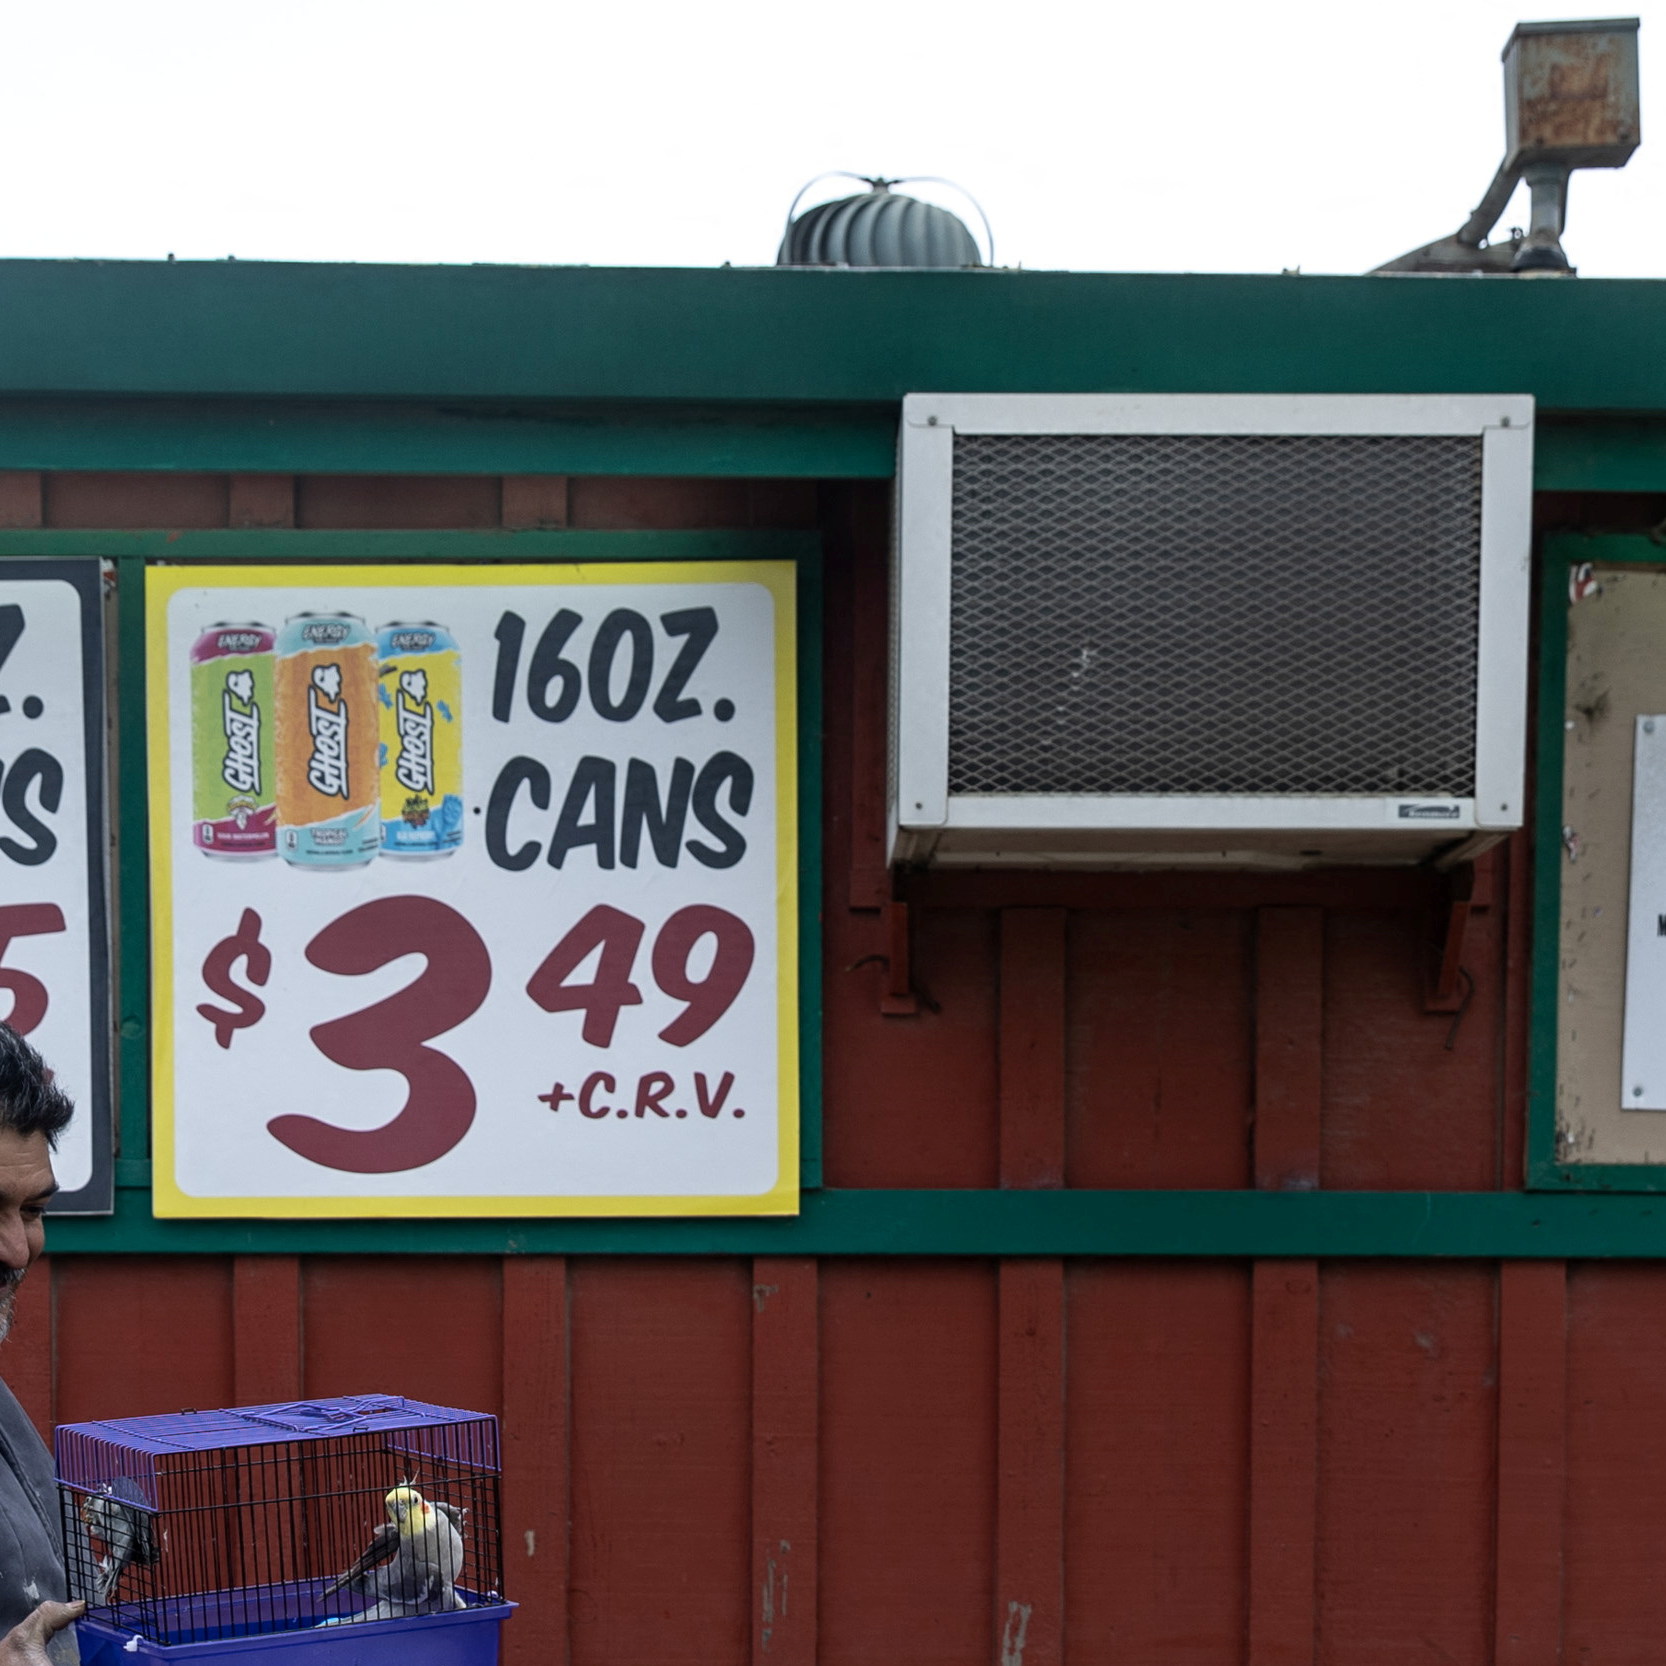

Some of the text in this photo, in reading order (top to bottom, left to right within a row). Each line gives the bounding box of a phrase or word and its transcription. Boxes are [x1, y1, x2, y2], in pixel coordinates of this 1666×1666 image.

[217, 633, 262, 648] ENERGY
[302, 624, 351, 640] ENERGY
[391, 633, 435, 648] ENERGY
[222, 689, 261, 795] GHOST
[308, 684, 349, 800] GHOST
[396, 688, 434, 795] GHOST
[485, 750, 754, 871] CANS
[538, 1070, 746, 1120] +C.R.V.
